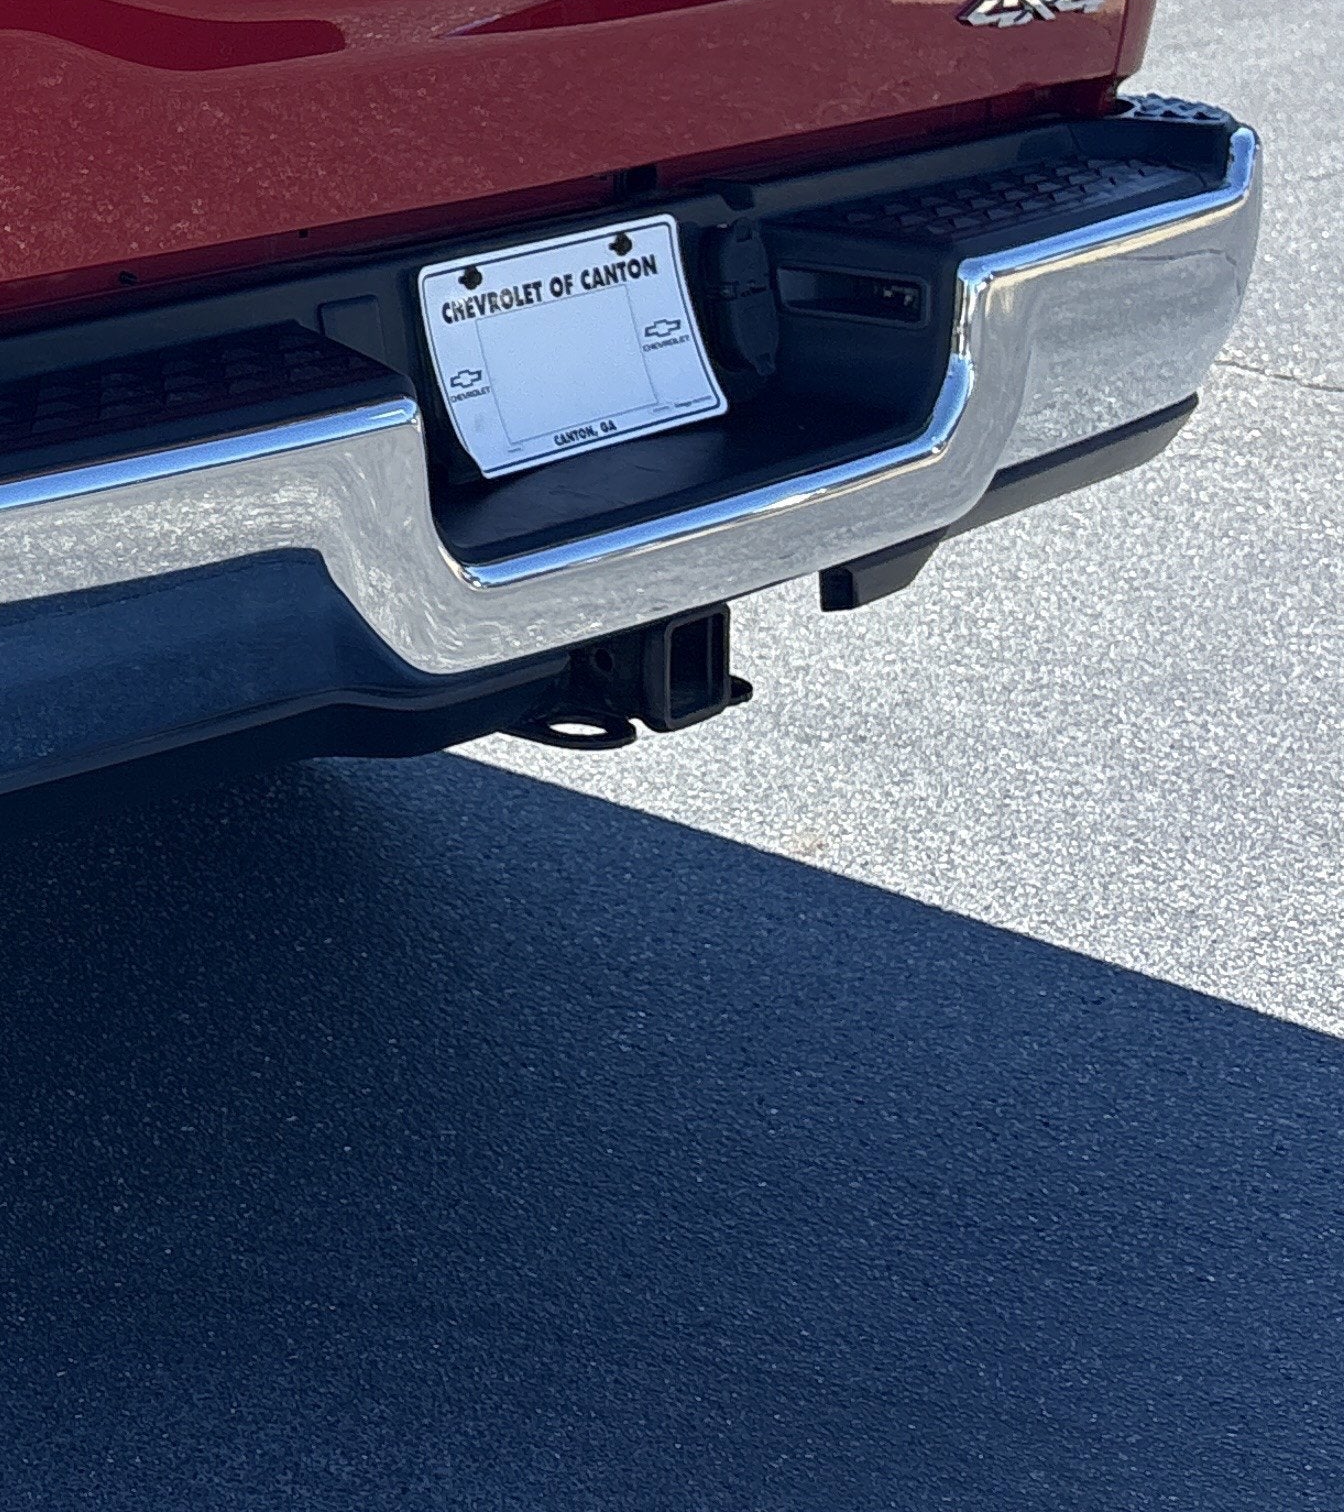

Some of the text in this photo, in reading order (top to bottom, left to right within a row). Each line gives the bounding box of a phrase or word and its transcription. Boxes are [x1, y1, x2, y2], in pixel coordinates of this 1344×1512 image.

[441, 254, 658, 324] CHEVROLET OF CANTON
[449, 386, 490, 403] CHEVROLET
[599, 419, 617, 433] GA
